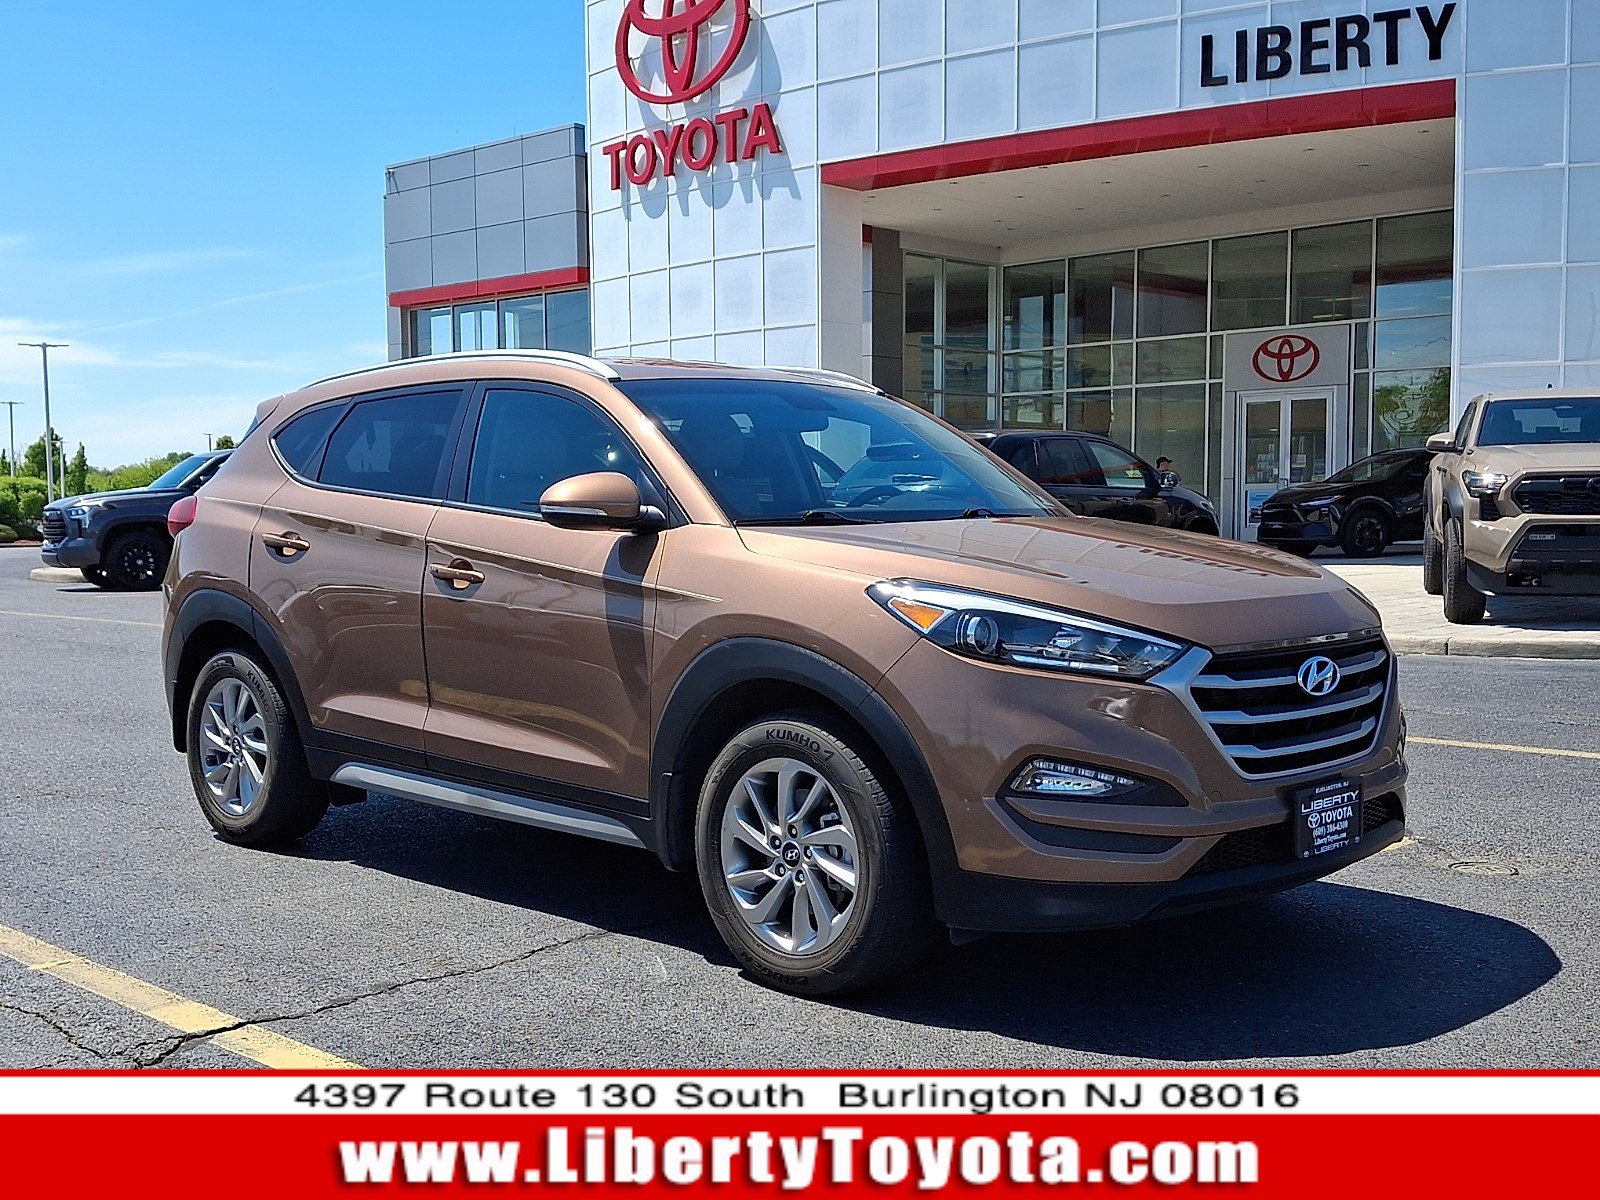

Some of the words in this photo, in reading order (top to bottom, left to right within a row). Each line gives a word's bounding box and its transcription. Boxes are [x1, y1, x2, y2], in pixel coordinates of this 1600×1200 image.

[1200, 3, 1456, 88] LIBERTY
[603, 103, 782, 190] TOYOTA
[765, 729, 821, 752] KUMHO
[1301, 790, 1359, 813] LIBERTY
[1321, 806, 1353, 824] TOYOTA
[1314, 840, 1350, 854] LIBERTY
